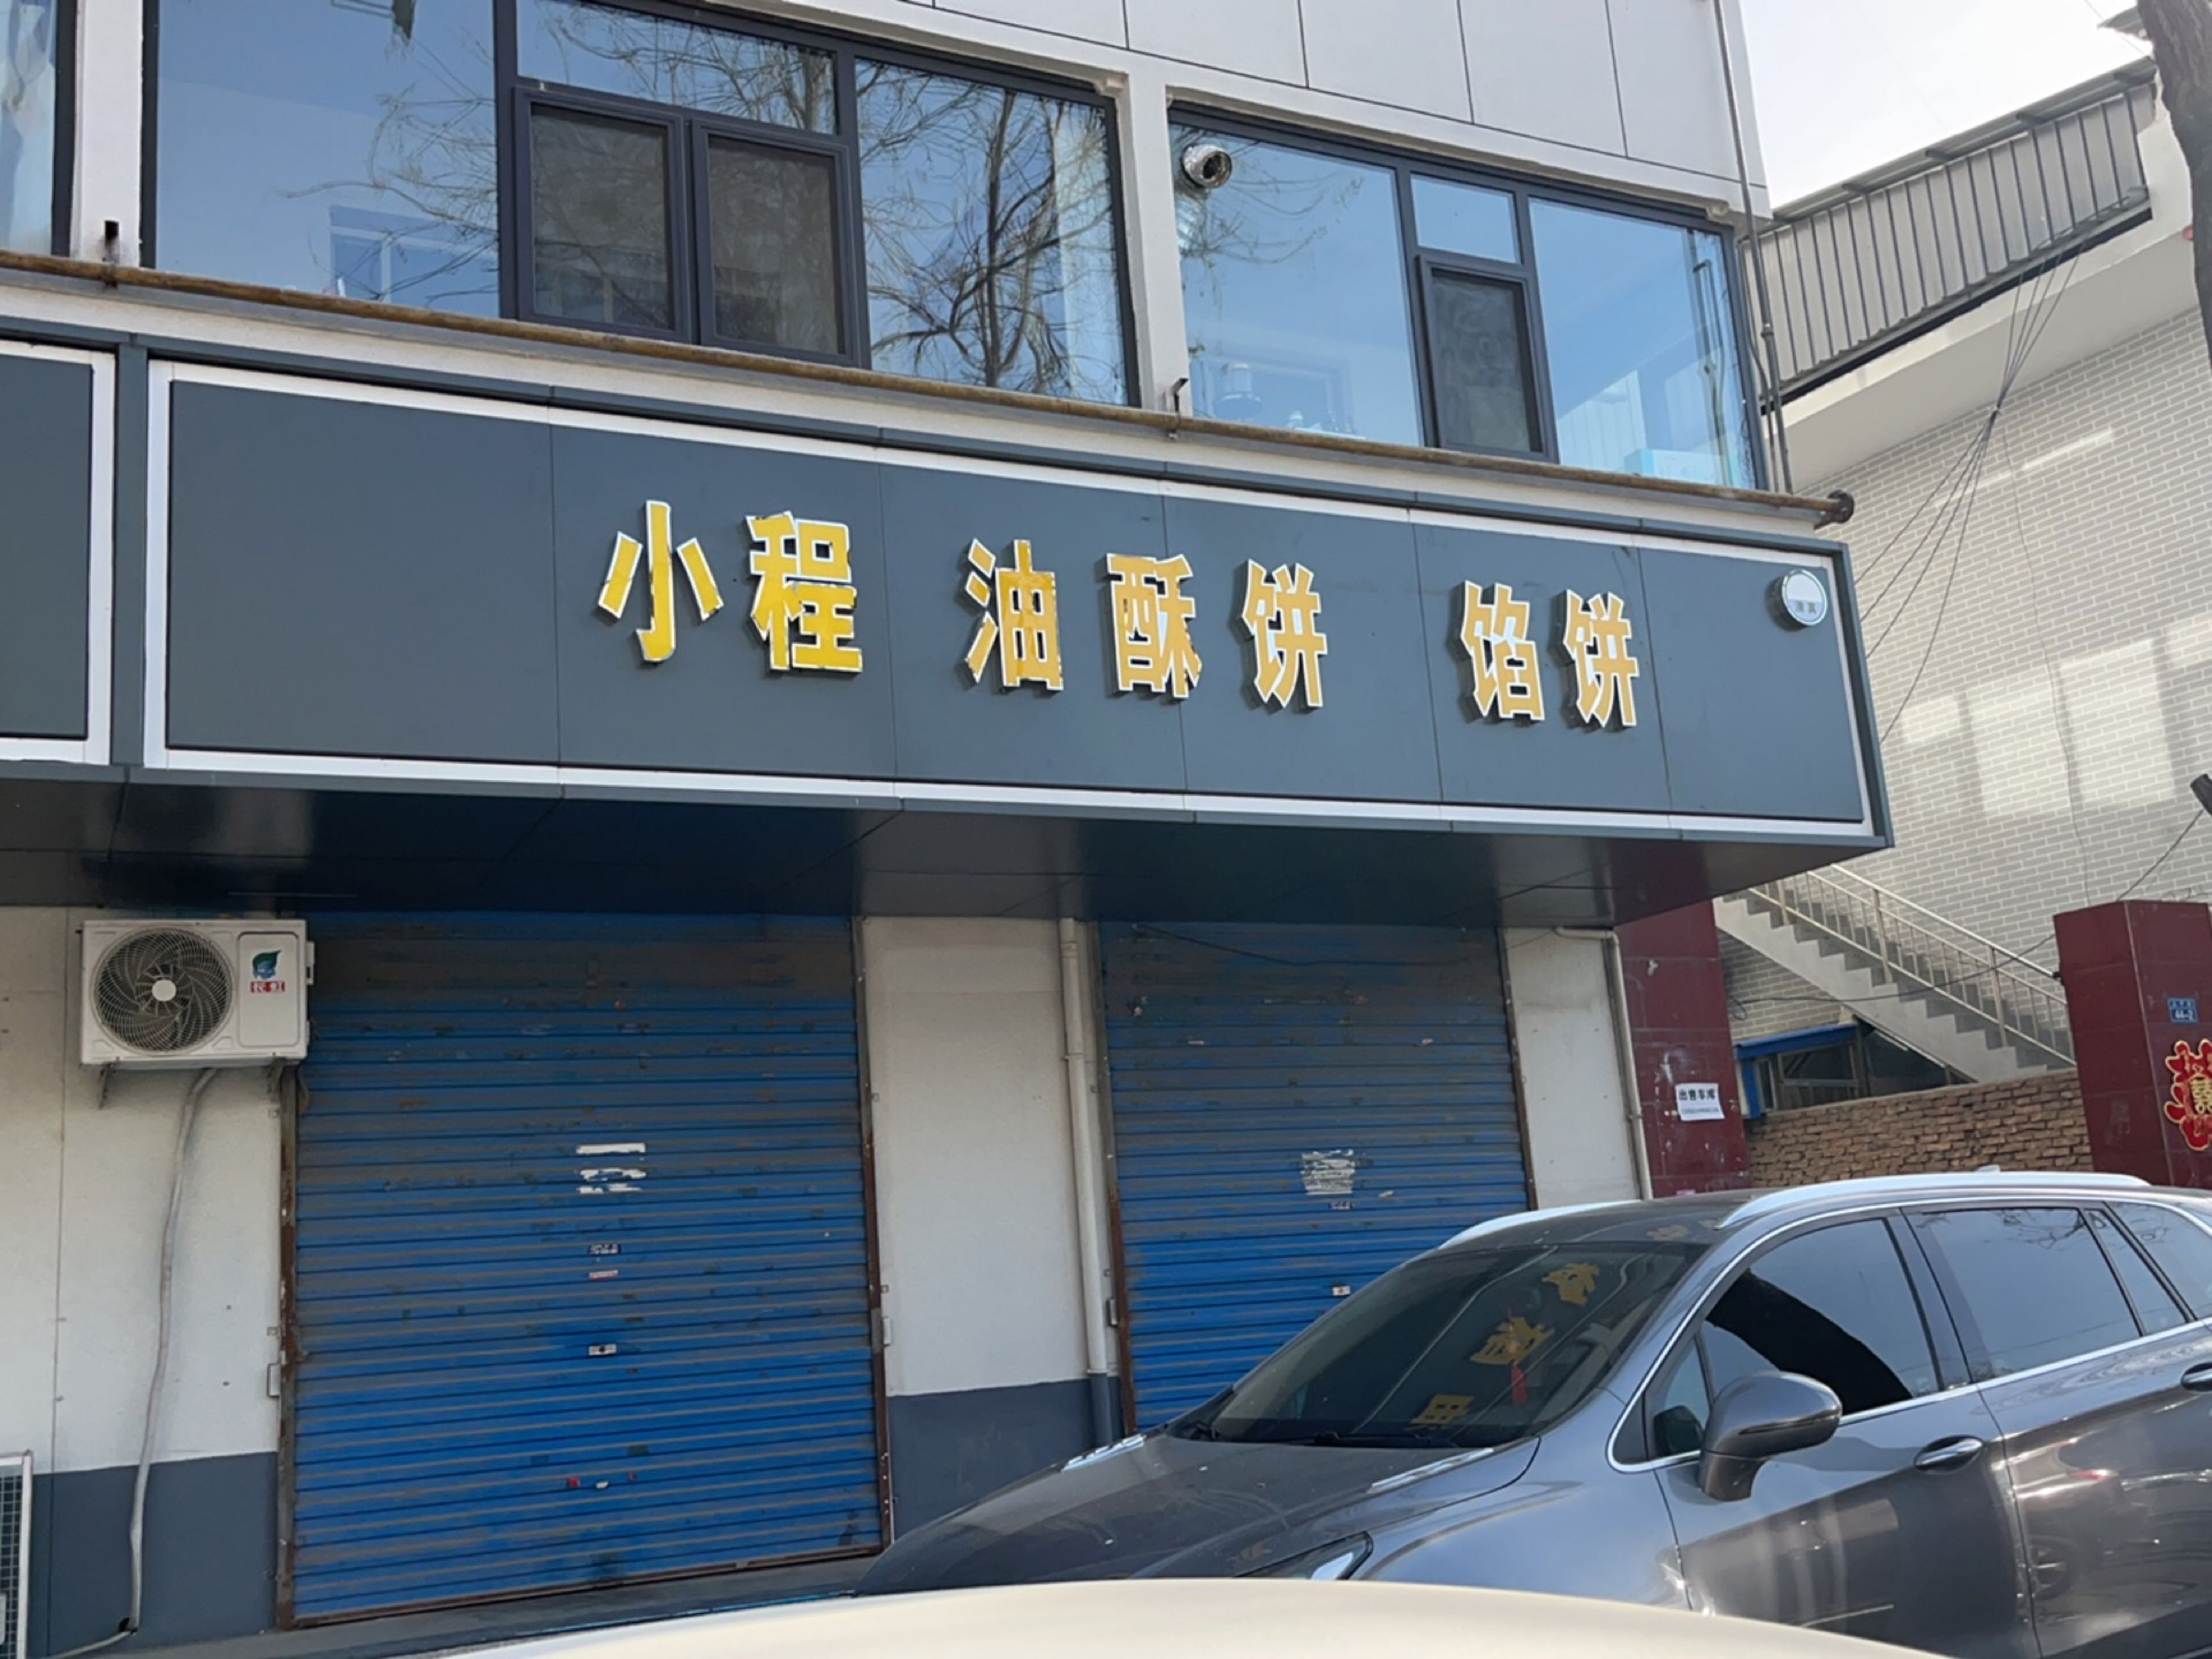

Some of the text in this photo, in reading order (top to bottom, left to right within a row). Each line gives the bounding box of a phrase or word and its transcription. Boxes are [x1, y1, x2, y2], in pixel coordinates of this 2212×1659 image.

[598, 499, 1640, 728] 小程 油酥饼 馅饼
